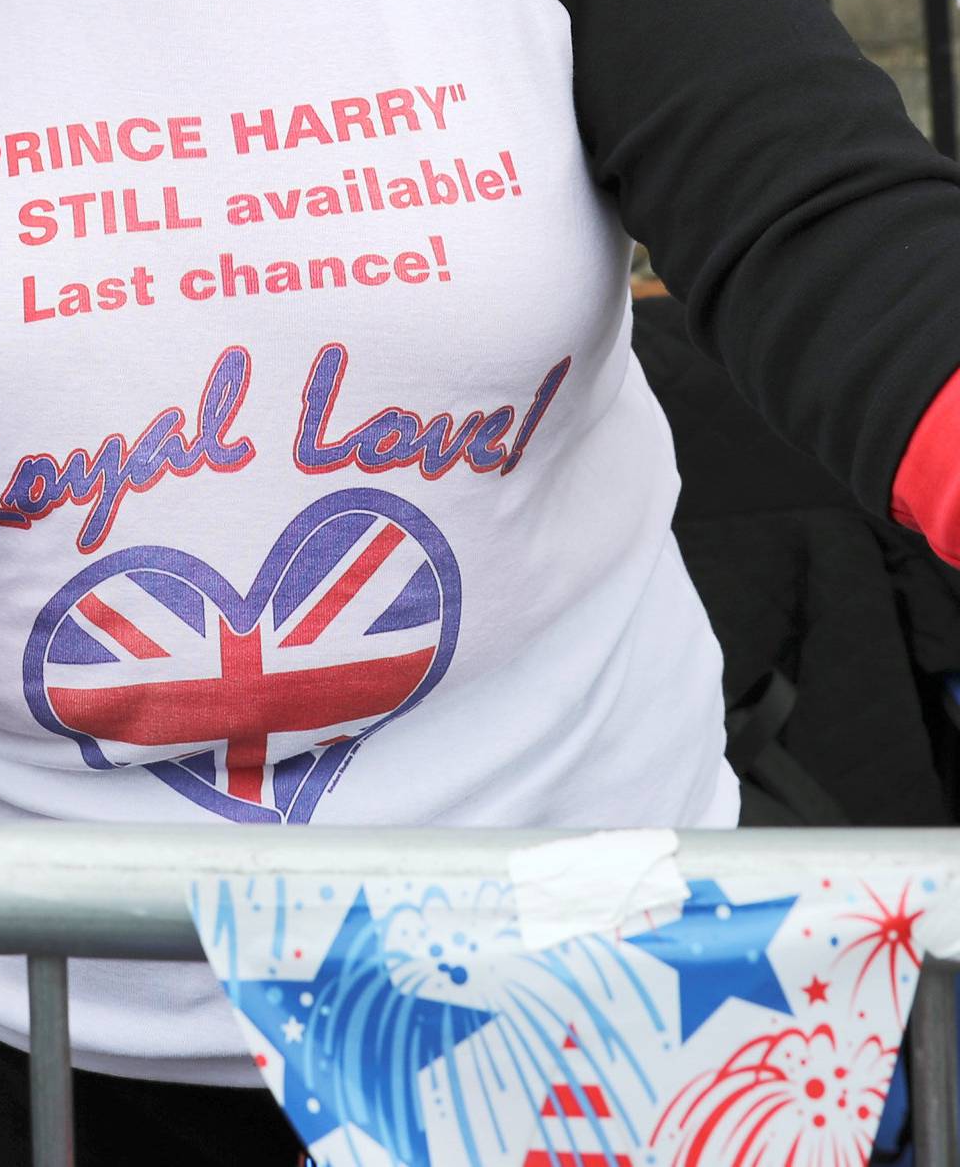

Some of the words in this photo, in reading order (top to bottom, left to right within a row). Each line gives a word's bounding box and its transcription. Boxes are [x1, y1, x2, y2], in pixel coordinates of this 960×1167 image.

[230, 83, 467, 155] HARRY"
[18, 186, 202, 247] STILL
[226, 151, 522, 226] available!
[23, 266, 155, 323] Last
[179, 236, 452, 302] chance!
[293, 342, 571, 480] Love!
